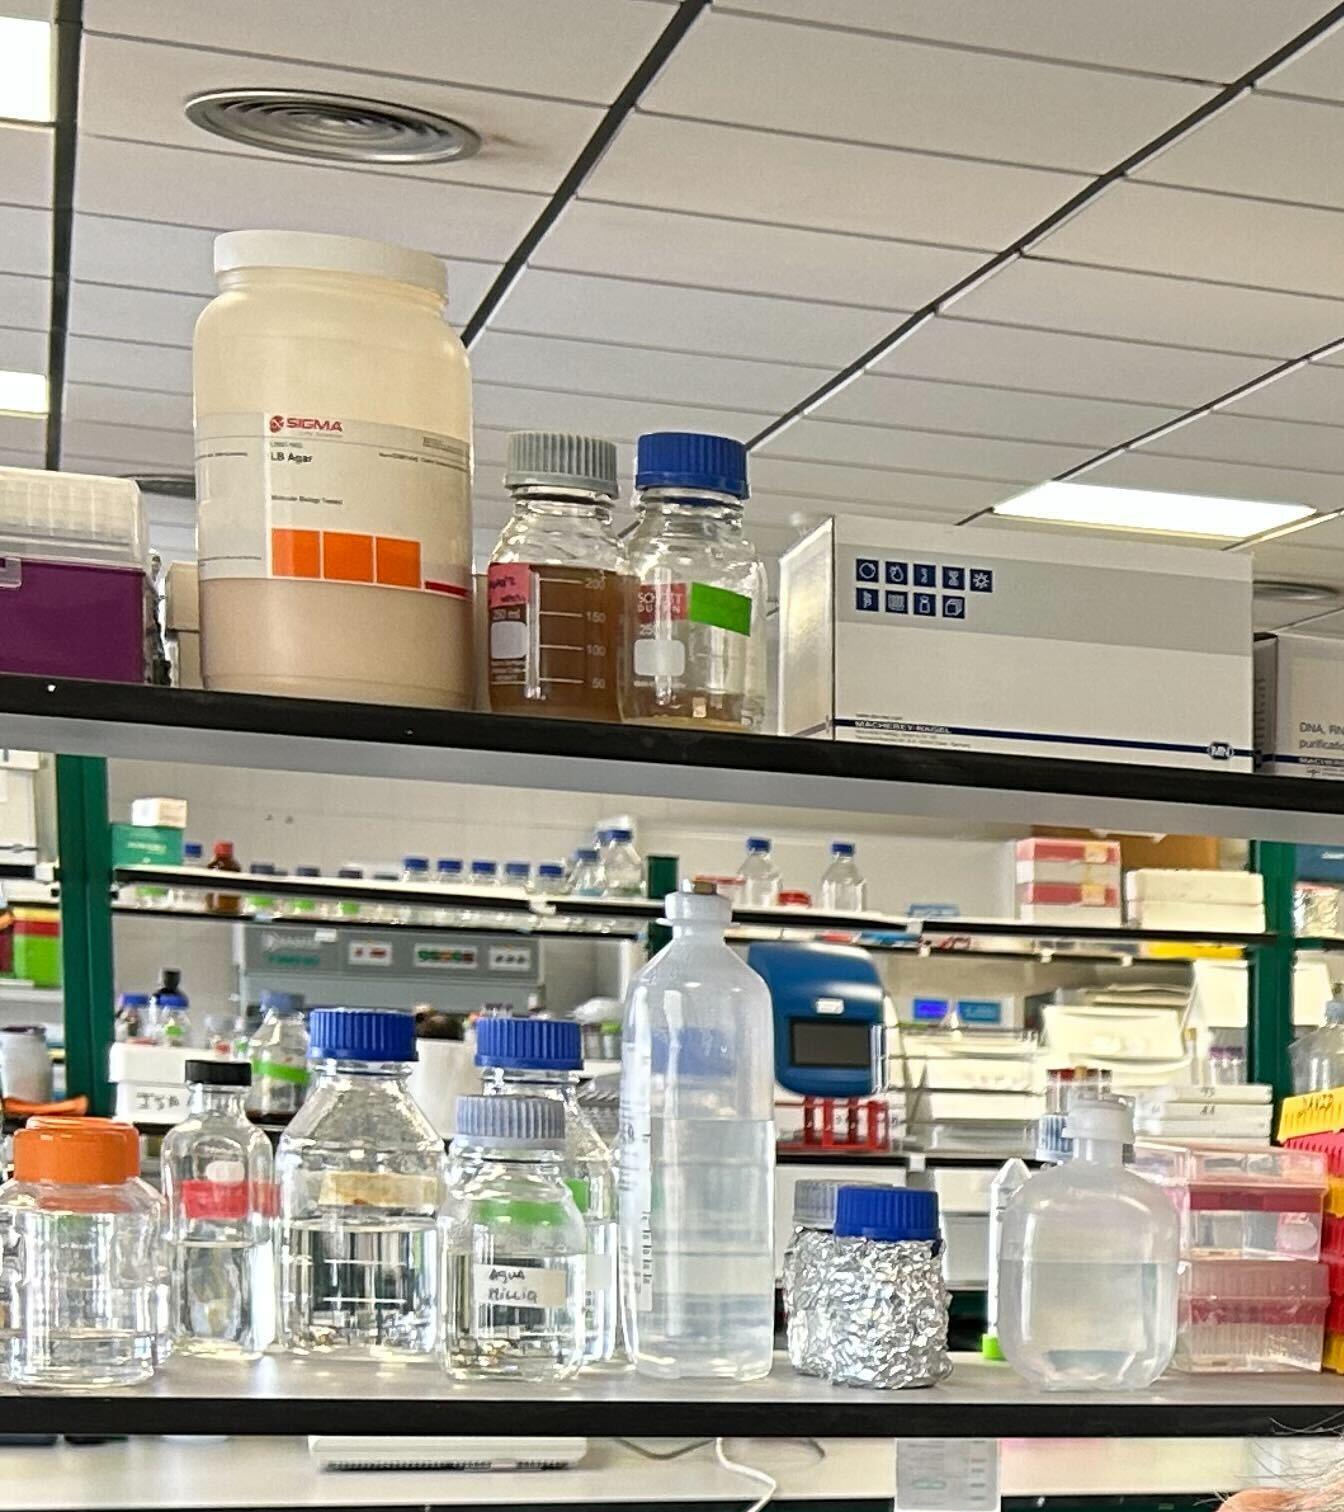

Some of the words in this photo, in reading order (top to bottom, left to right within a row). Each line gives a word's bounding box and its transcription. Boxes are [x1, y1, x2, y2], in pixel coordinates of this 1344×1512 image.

[286, 417, 343, 432] SIGMA
[271, 451, 284, 461] LB
[288, 452, 313, 464] Agar
